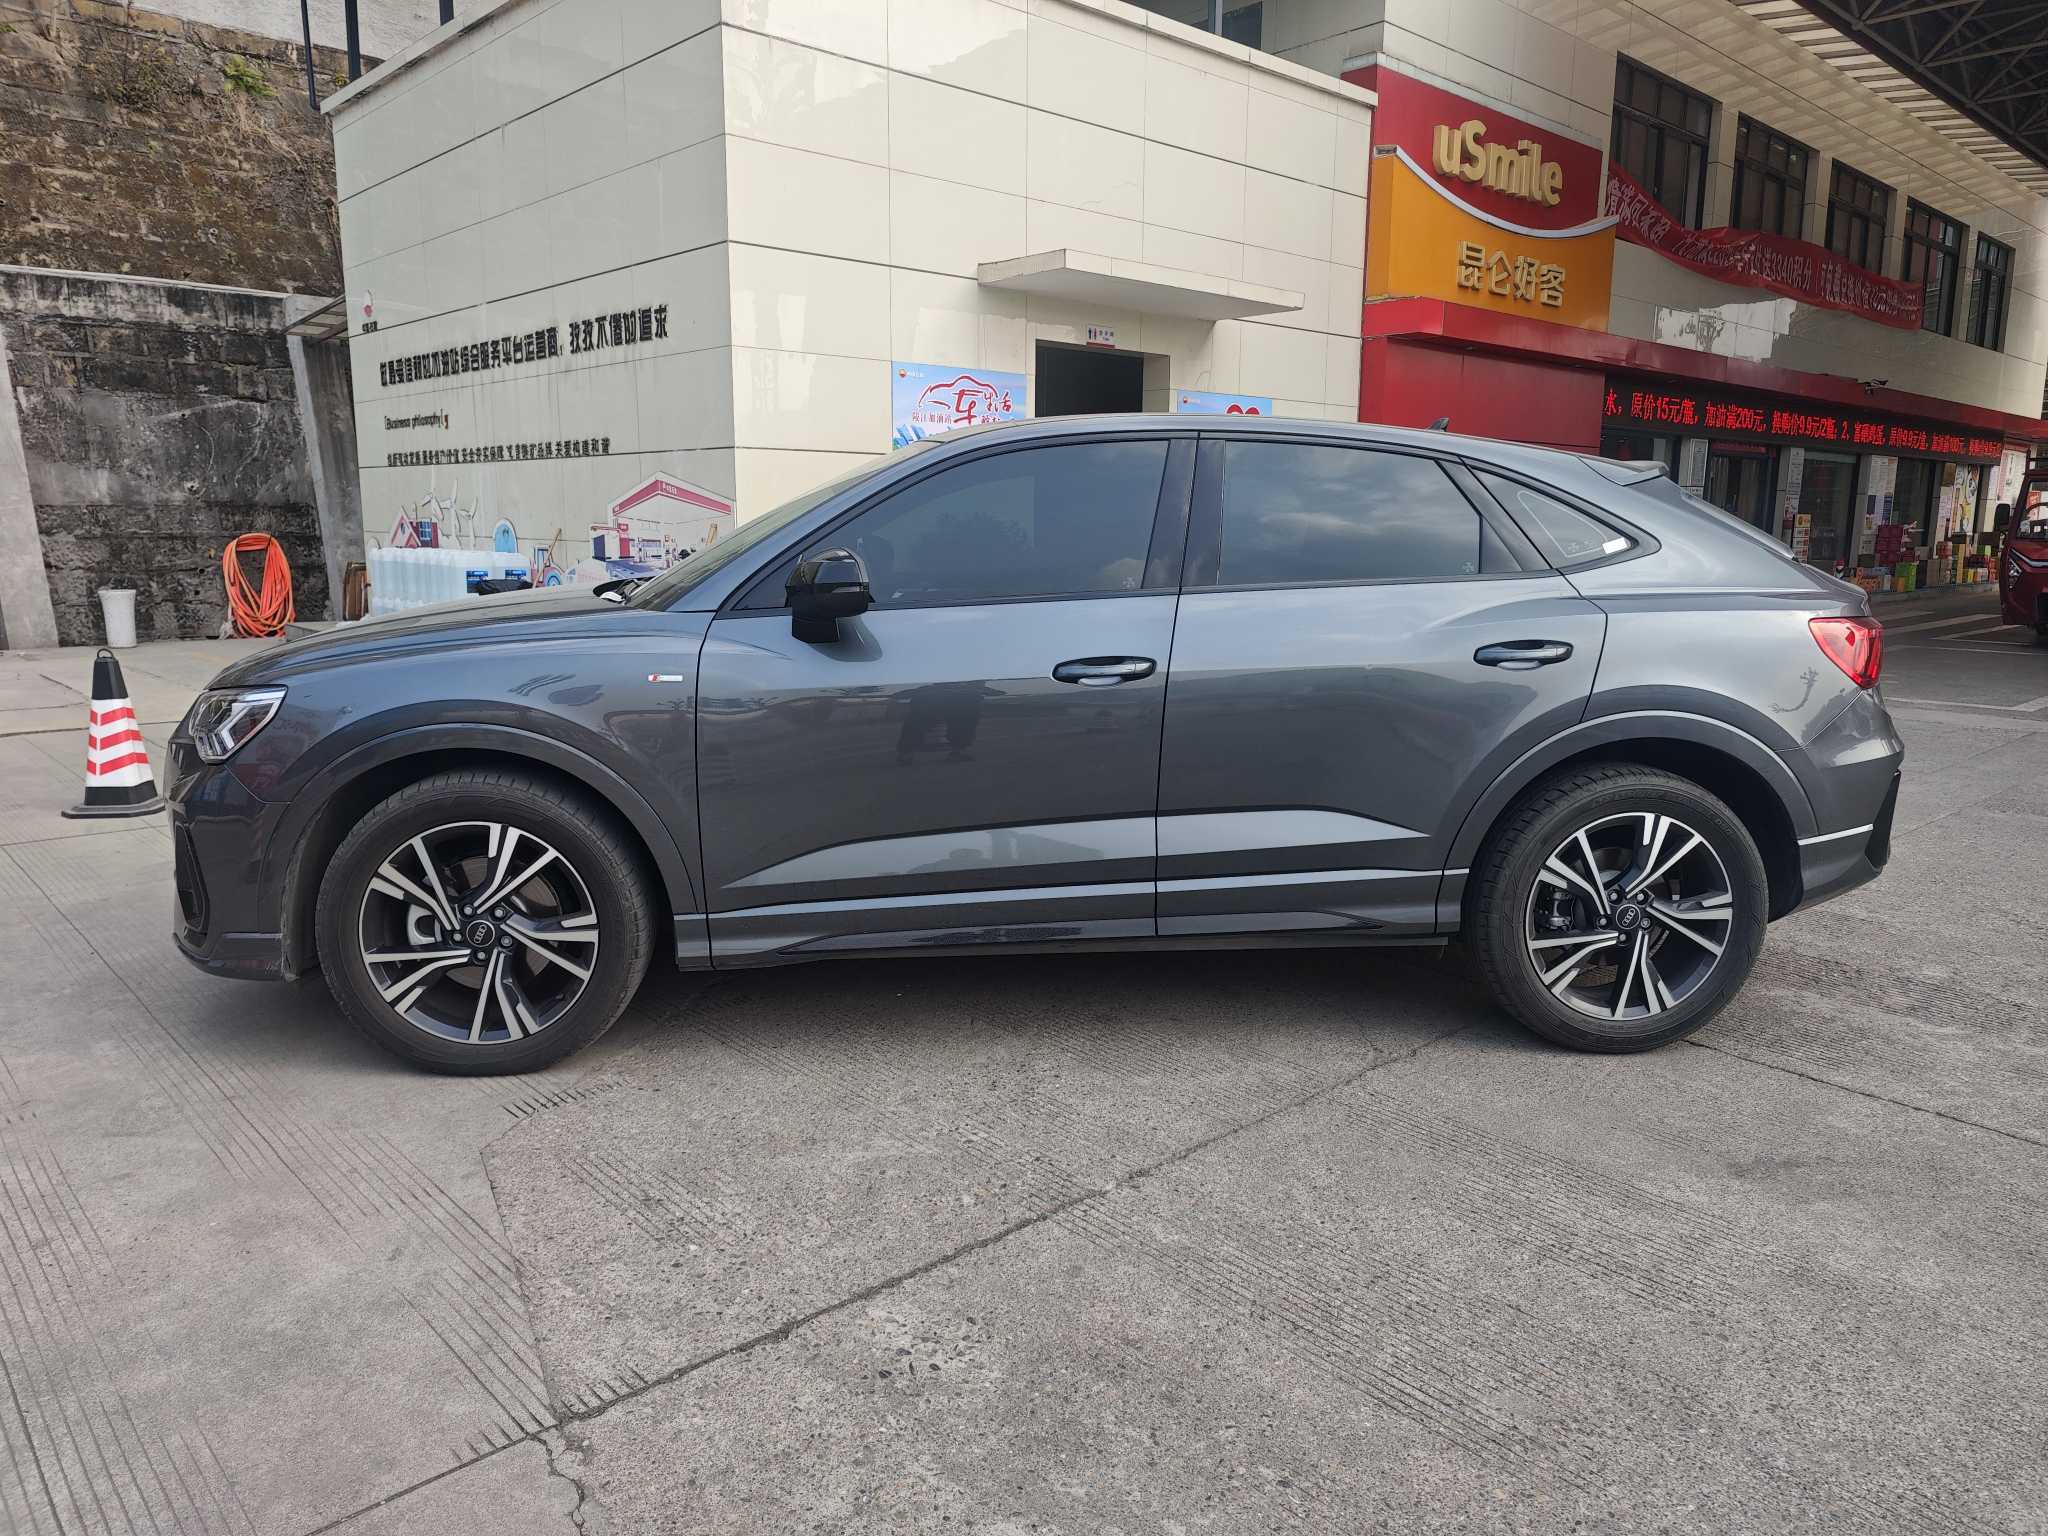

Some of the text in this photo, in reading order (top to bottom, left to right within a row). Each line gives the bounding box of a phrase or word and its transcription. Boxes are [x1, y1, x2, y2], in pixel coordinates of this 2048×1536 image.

[1432, 120, 1563, 207] uSmile
[1456, 240, 1567, 308] 昆仑好客
